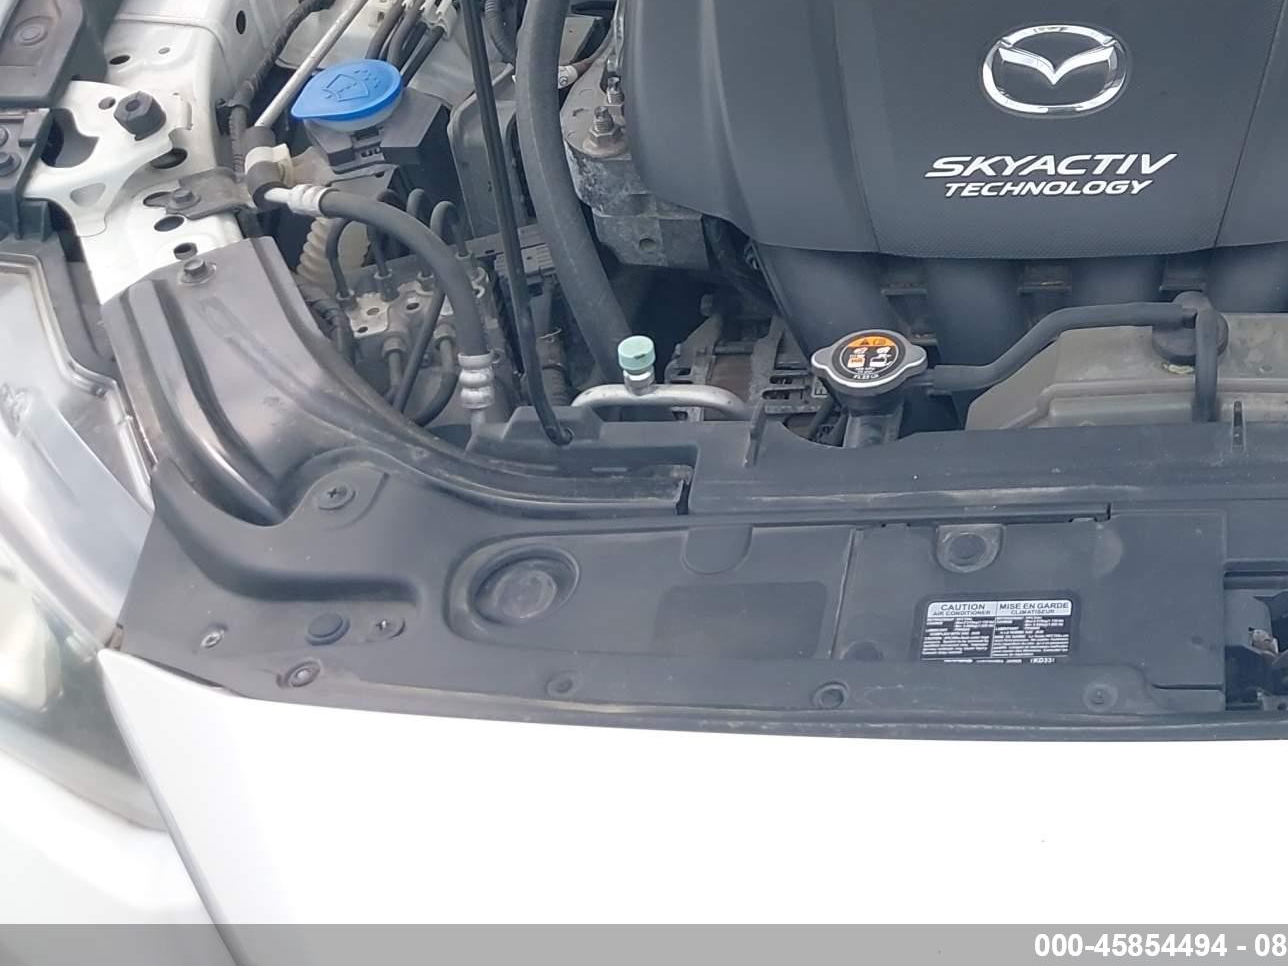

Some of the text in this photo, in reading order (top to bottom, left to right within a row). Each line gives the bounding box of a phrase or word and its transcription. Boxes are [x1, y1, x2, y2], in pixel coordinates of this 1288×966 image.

[924, 153, 1179, 177] SKYACTIV
[944, 179, 1154, 198] TECHNOLOGY
[940, 603, 986, 611] CAUTION
